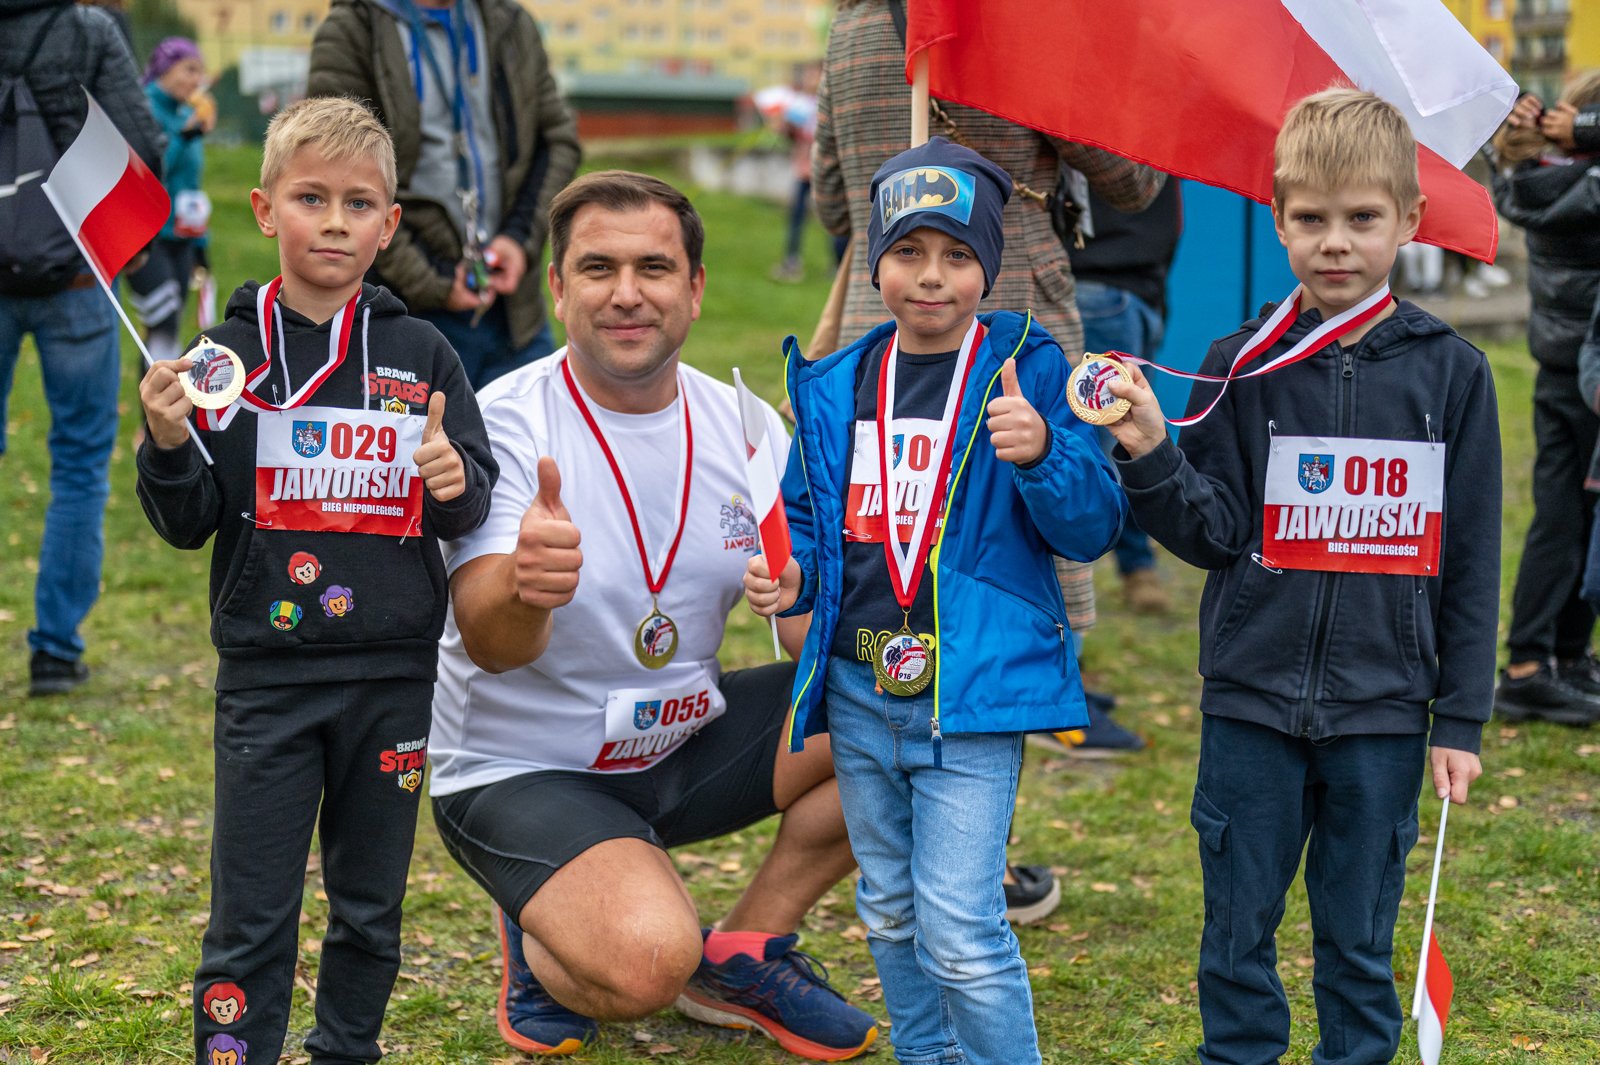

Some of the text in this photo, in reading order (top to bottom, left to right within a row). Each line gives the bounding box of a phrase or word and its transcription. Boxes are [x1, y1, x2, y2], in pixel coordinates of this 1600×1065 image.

[361, 373, 430, 405] STARS
[376, 367, 418, 383] BRAWL
[331, 422, 397, 463] 029
[270, 467, 412, 501] JAWORSKI
[1344, 456, 1408, 497] 018
[322, 502, 342, 513] BIEG
[1274, 502, 1428, 540] JAWORSKI
[1328, 542, 1418, 556] BIEG NIEPODLEGŁOŚCI
[661, 690, 709, 727] 055
[380, 749, 426, 773] STA
[397, 737, 426, 753] BRAW
